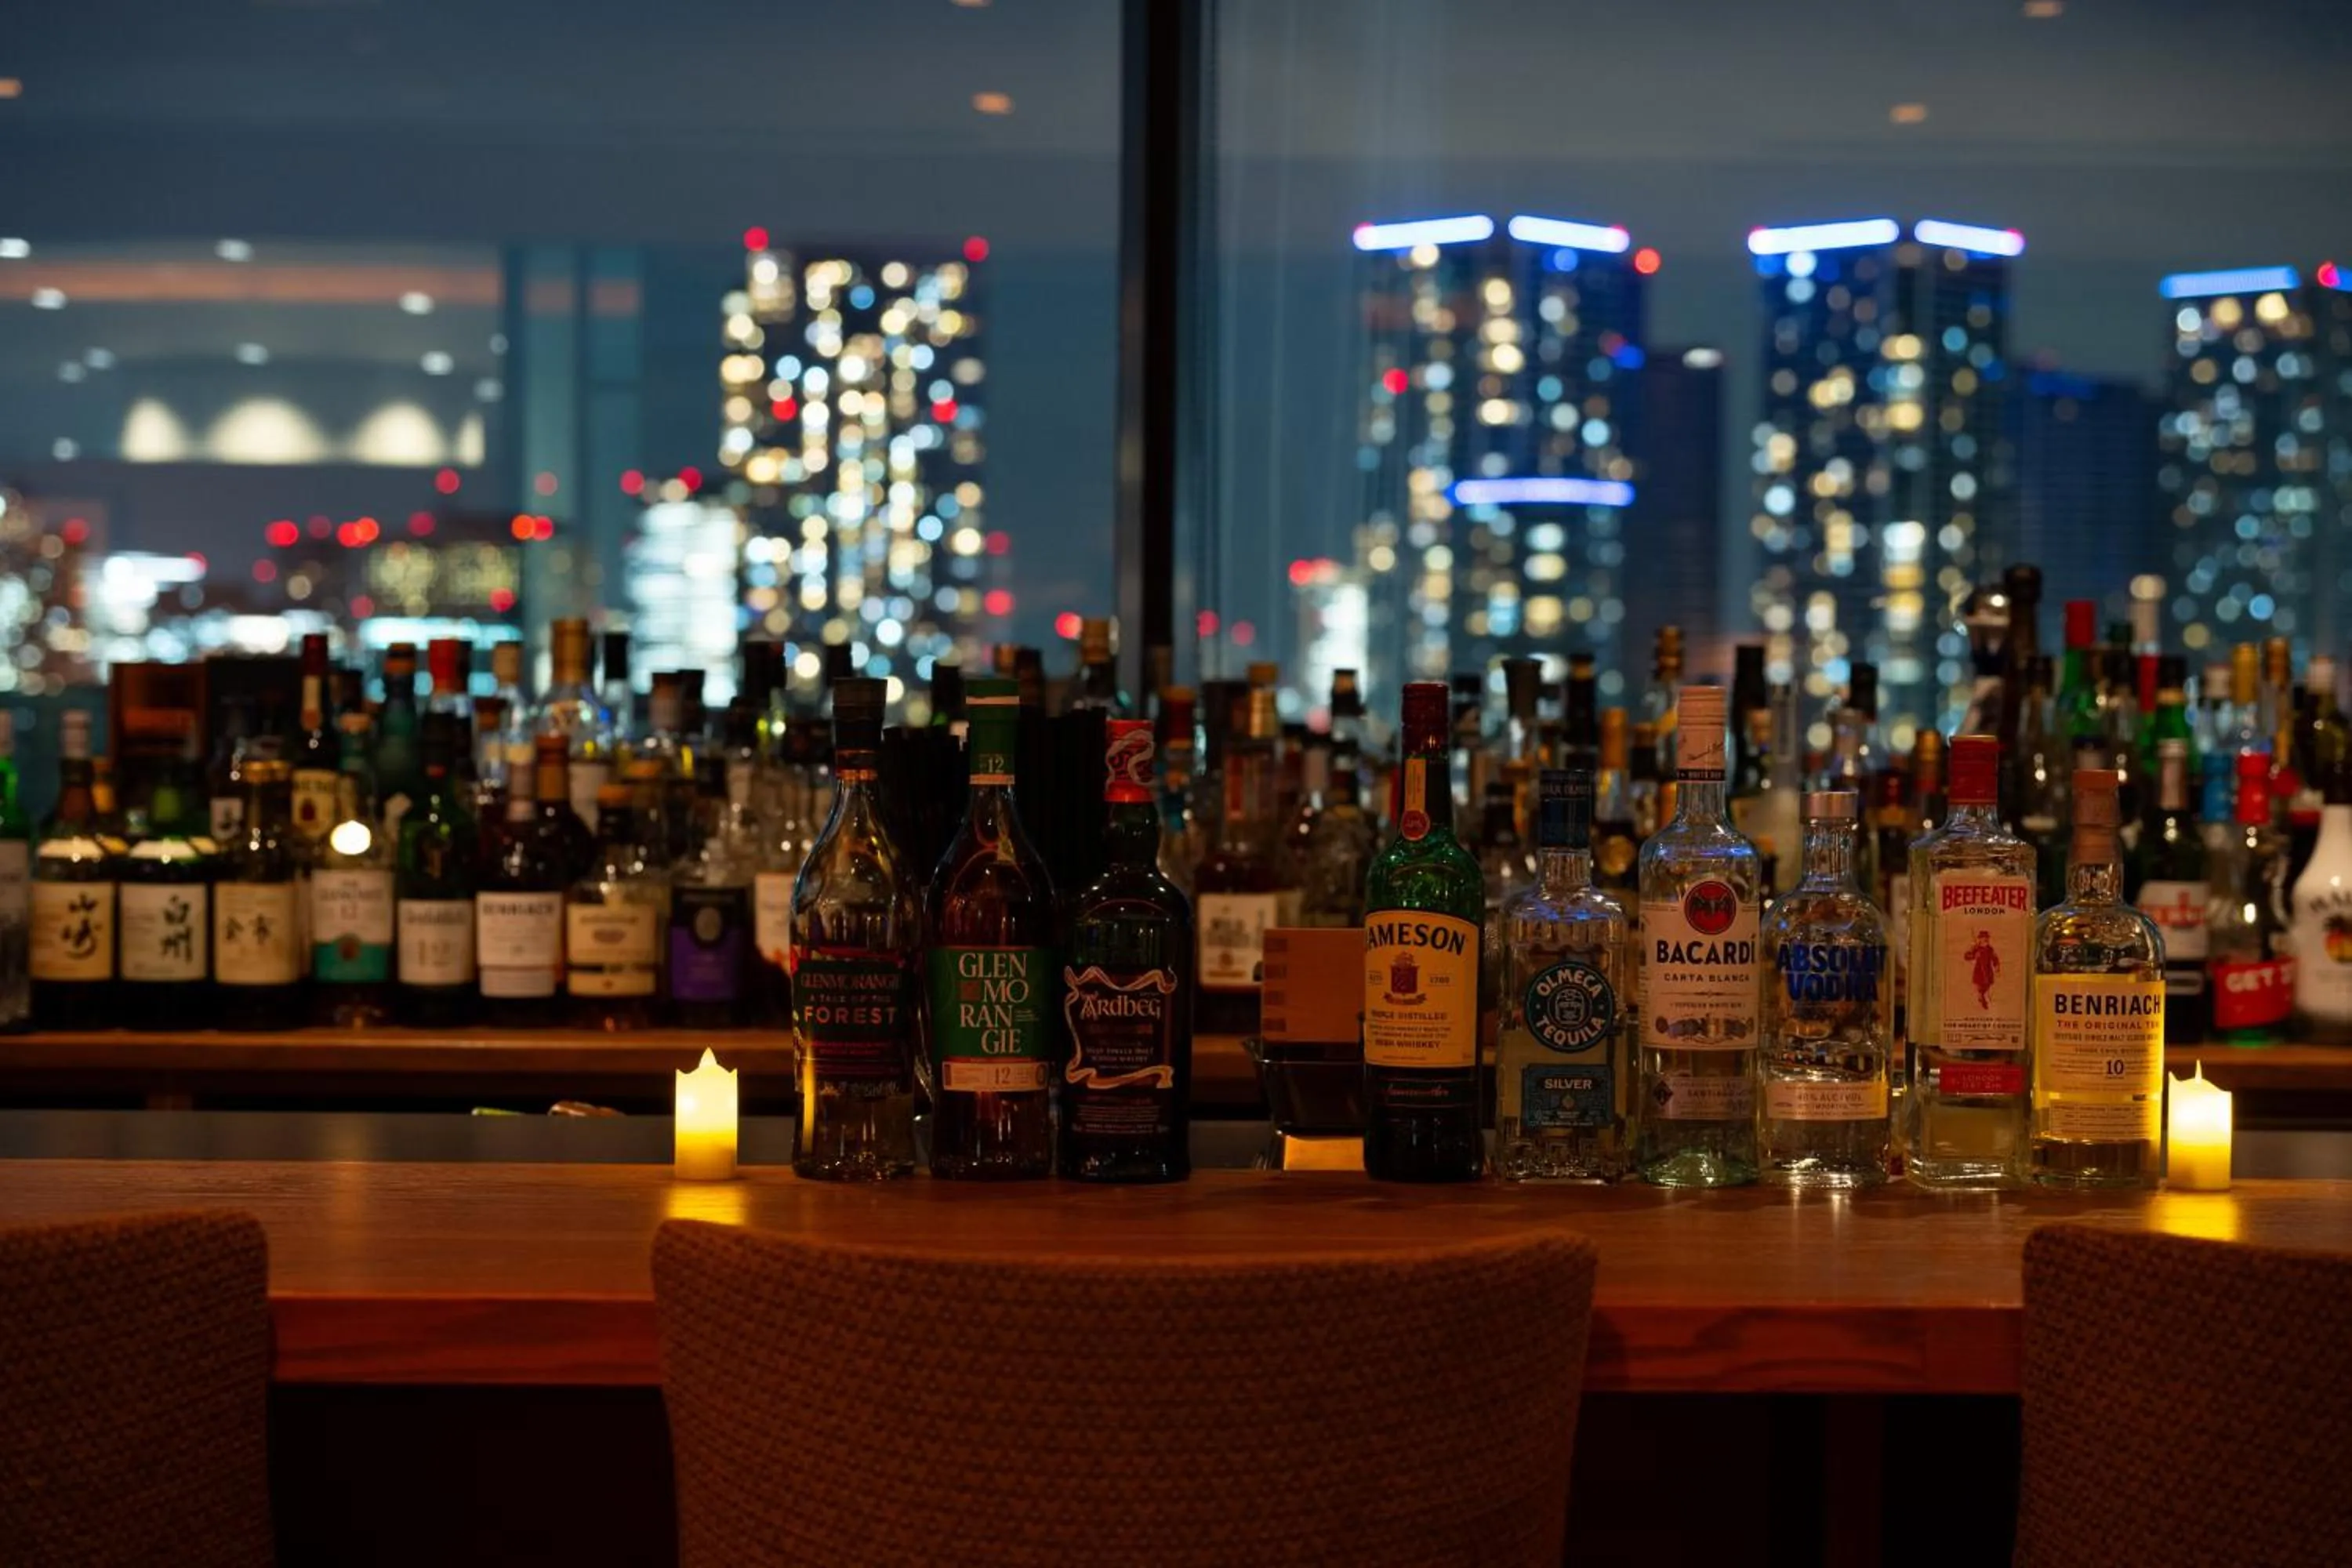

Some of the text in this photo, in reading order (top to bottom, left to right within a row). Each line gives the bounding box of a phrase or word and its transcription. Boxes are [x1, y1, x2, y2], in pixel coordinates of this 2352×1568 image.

[988, 754, 1004, 774] 12
[1942, 884, 2027, 912] BEEFEATER
[1366, 922, 1466, 956] AMESON
[959, 953, 1027, 978] GLEN
[1536, 968, 1603, 999] OLMECA
[1664, 973, 1703, 982] CARTA
[982, 979, 1029, 1004] MO
[804, 1005, 898, 1024] FOREST
[2054, 993, 2161, 1015] BENRIACH
[960, 1004, 1014, 1029] RAN
[2057, 1020, 2078, 1029] THE
[2085, 1021, 2143, 1030] ORIGINAL
[982, 1029, 1022, 1054] GIE
[1536, 1015, 1606, 1047] TEQUILA
[995, 1066, 1011, 1084] 12
[2106, 1059, 2124, 1075] 10
[1544, 1078, 1592, 1090] SILVER
